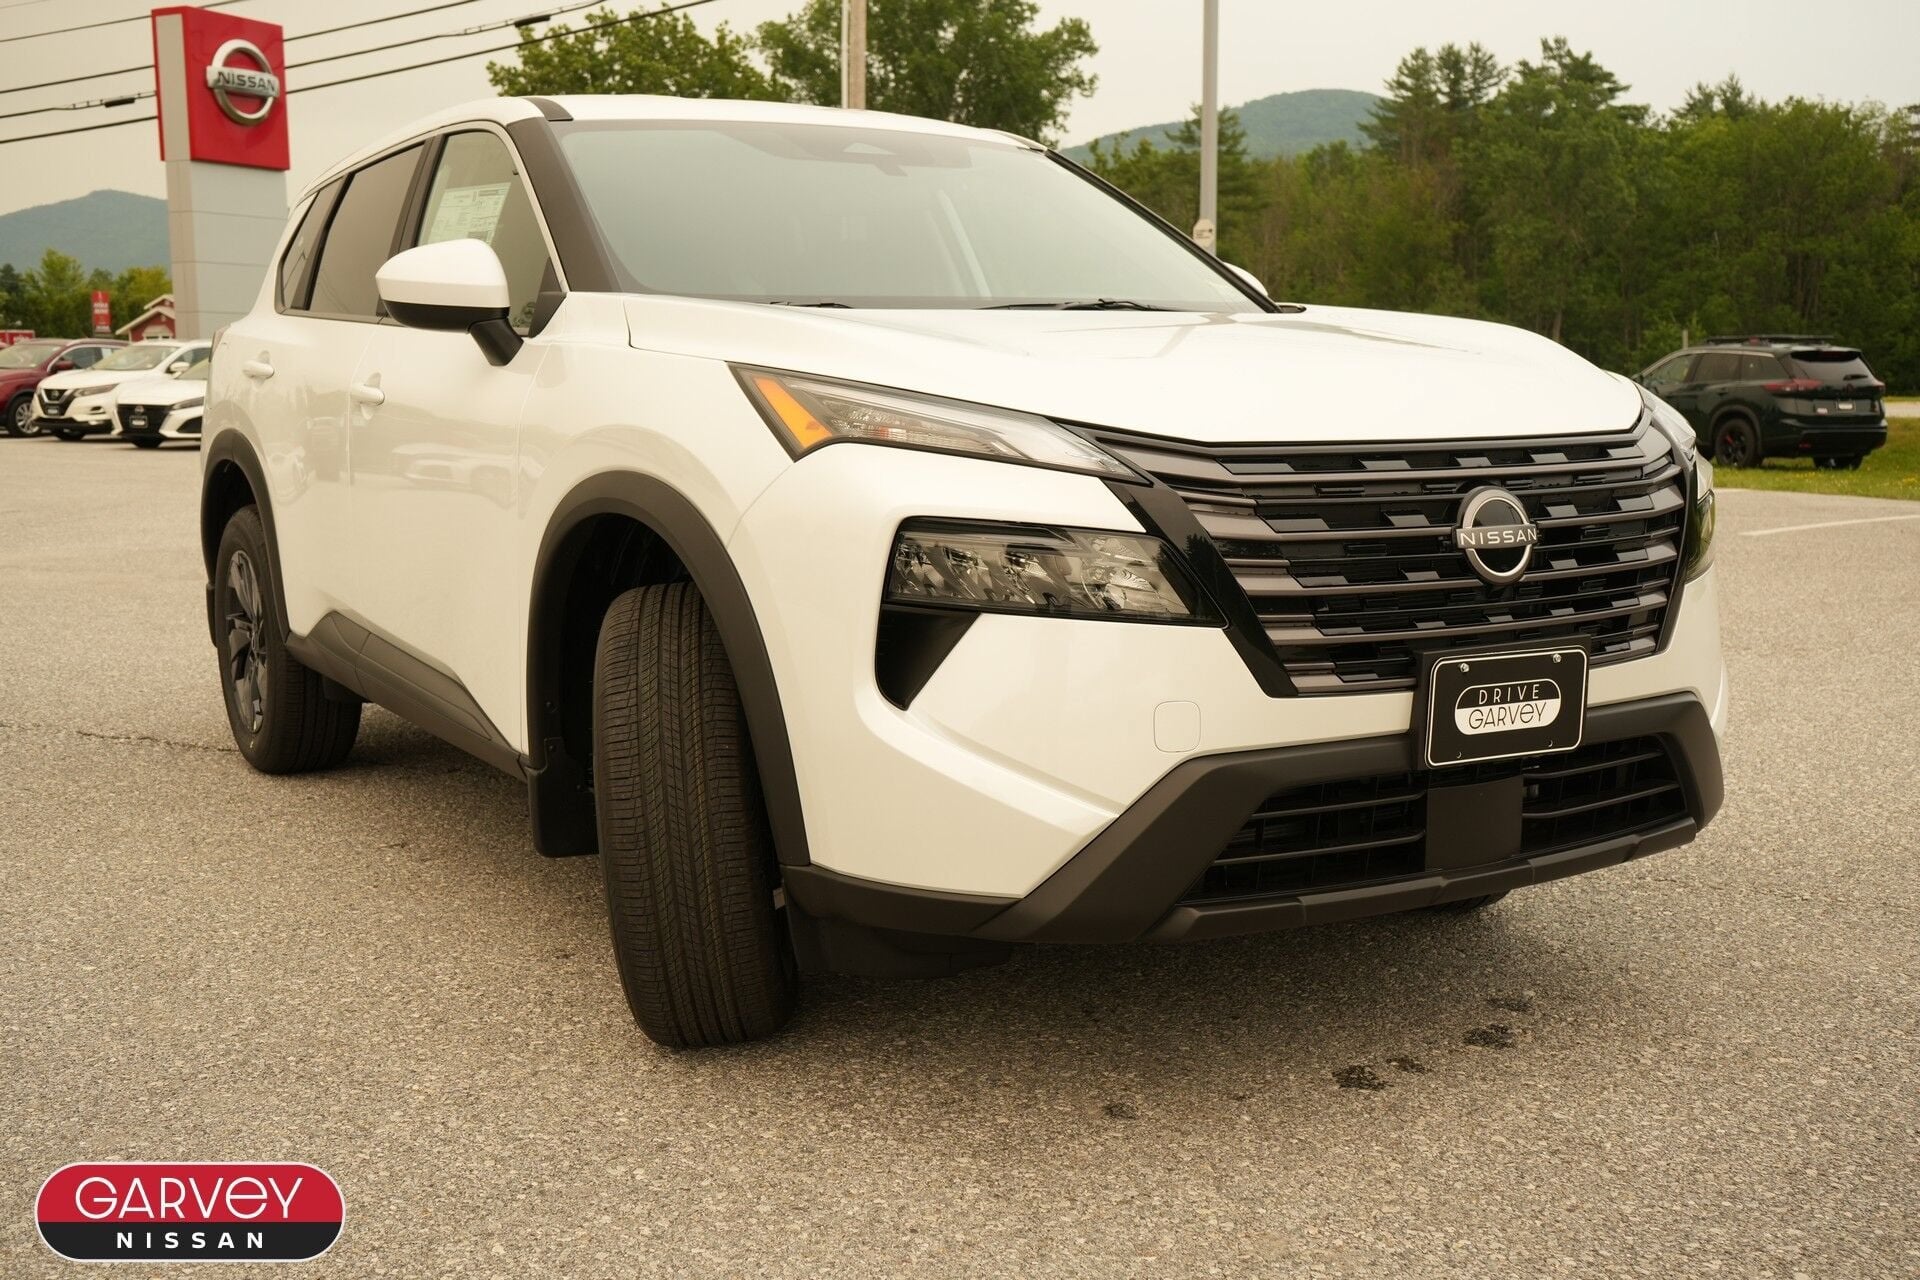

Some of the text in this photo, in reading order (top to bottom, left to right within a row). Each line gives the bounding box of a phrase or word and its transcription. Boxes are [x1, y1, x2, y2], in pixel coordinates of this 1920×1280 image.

[217, 71, 276, 92] NISSAN
[1460, 527, 1537, 546] NISSAN
[1478, 683, 1540, 705] DRIVE
[1468, 701, 1546, 730] GARVEY
